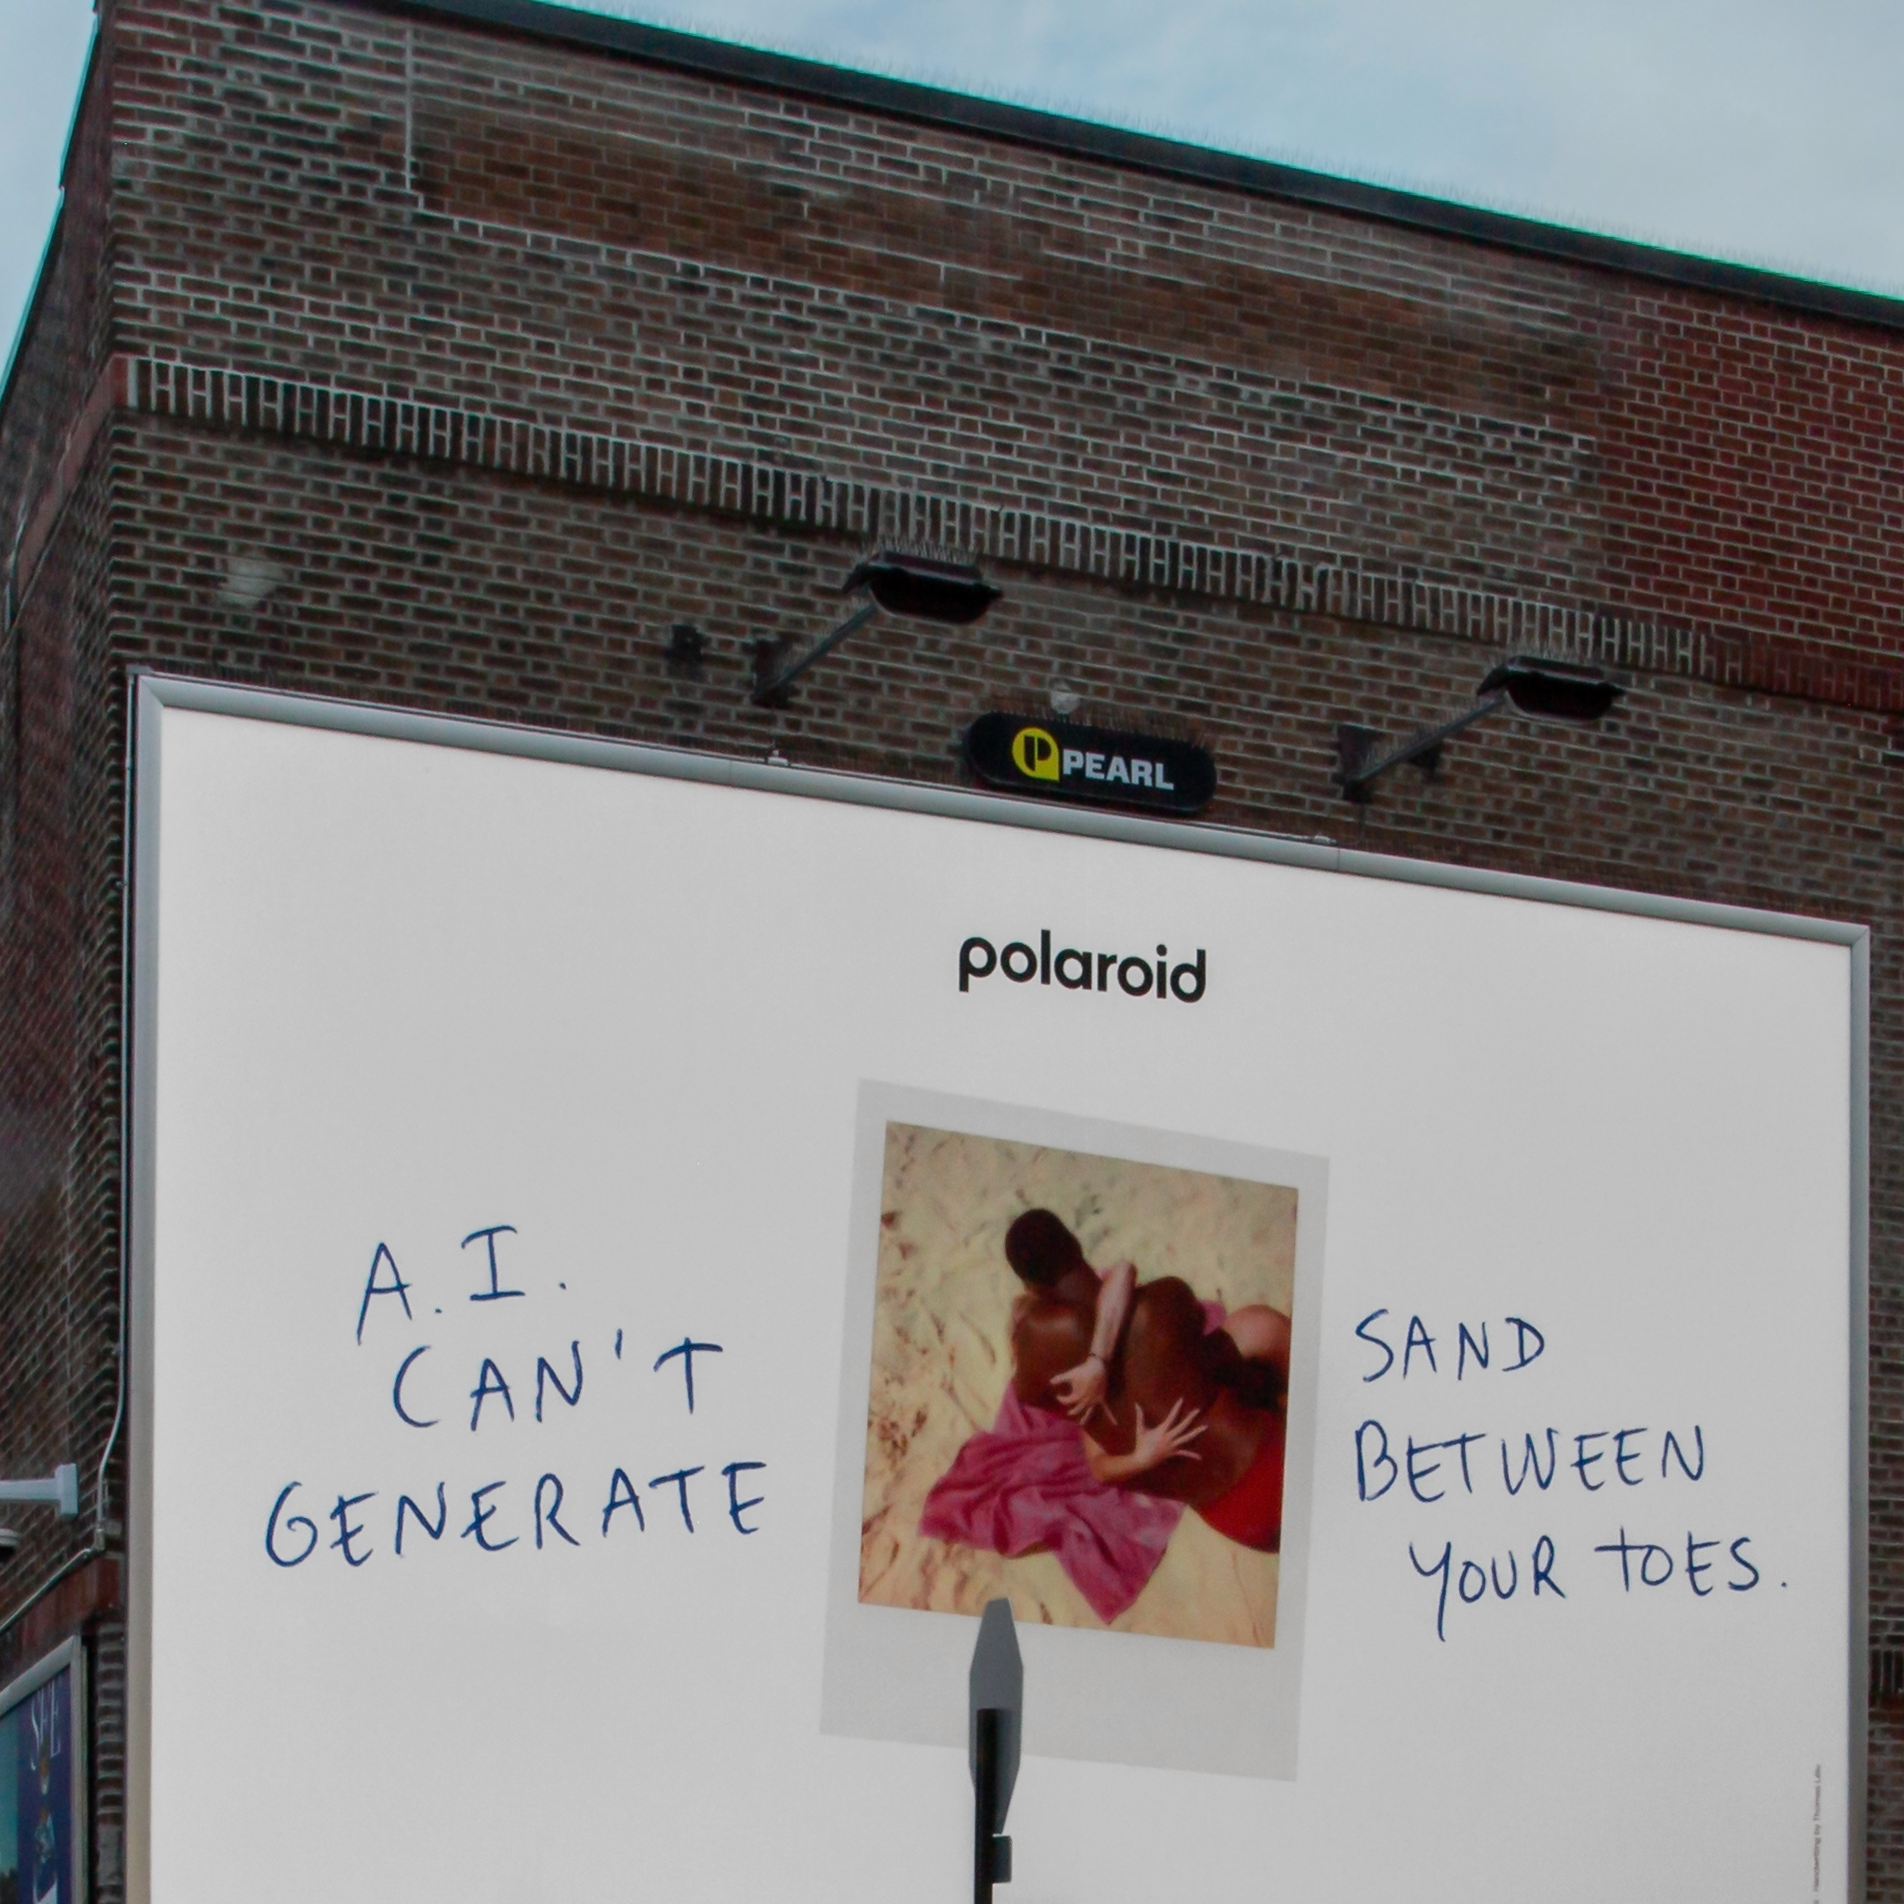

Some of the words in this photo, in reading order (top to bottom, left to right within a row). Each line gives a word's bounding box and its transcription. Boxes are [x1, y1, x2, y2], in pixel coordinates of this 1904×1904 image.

[1062, 748, 1175, 791] PEARL
[957, 928, 1207, 1004] polaroid
[356, 1224, 567, 1346] A.I.
[391, 1327, 724, 1432] CAN'T
[1354, 1308, 1545, 1383] SAND
[1354, 1419, 1704, 1503] BETWEEN
[264, 1461, 768, 1568] GENERATE
[1408, 1534, 1566, 1643] YOUR
